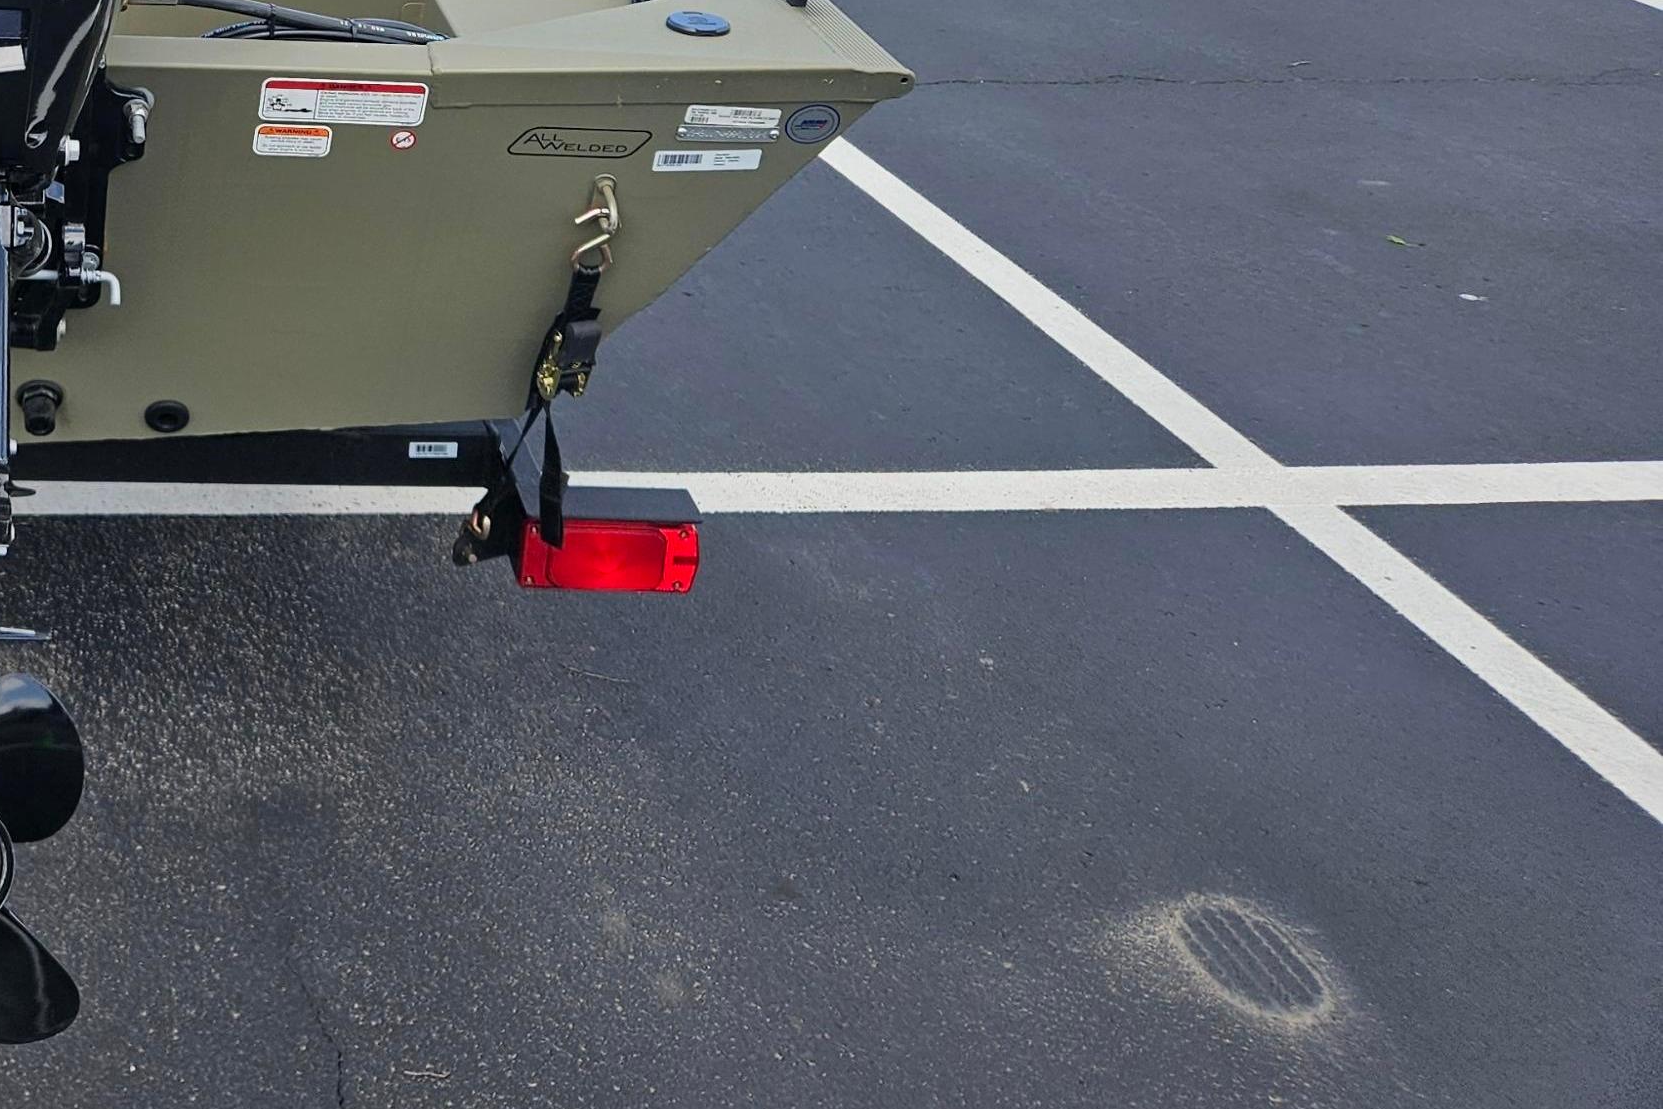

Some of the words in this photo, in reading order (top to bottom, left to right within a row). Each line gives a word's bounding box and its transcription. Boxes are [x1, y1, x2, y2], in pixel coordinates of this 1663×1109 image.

[275, 128, 313, 136] WARNING
[524, 133, 564, 145] ALL
[537, 141, 628, 153] WELDED
